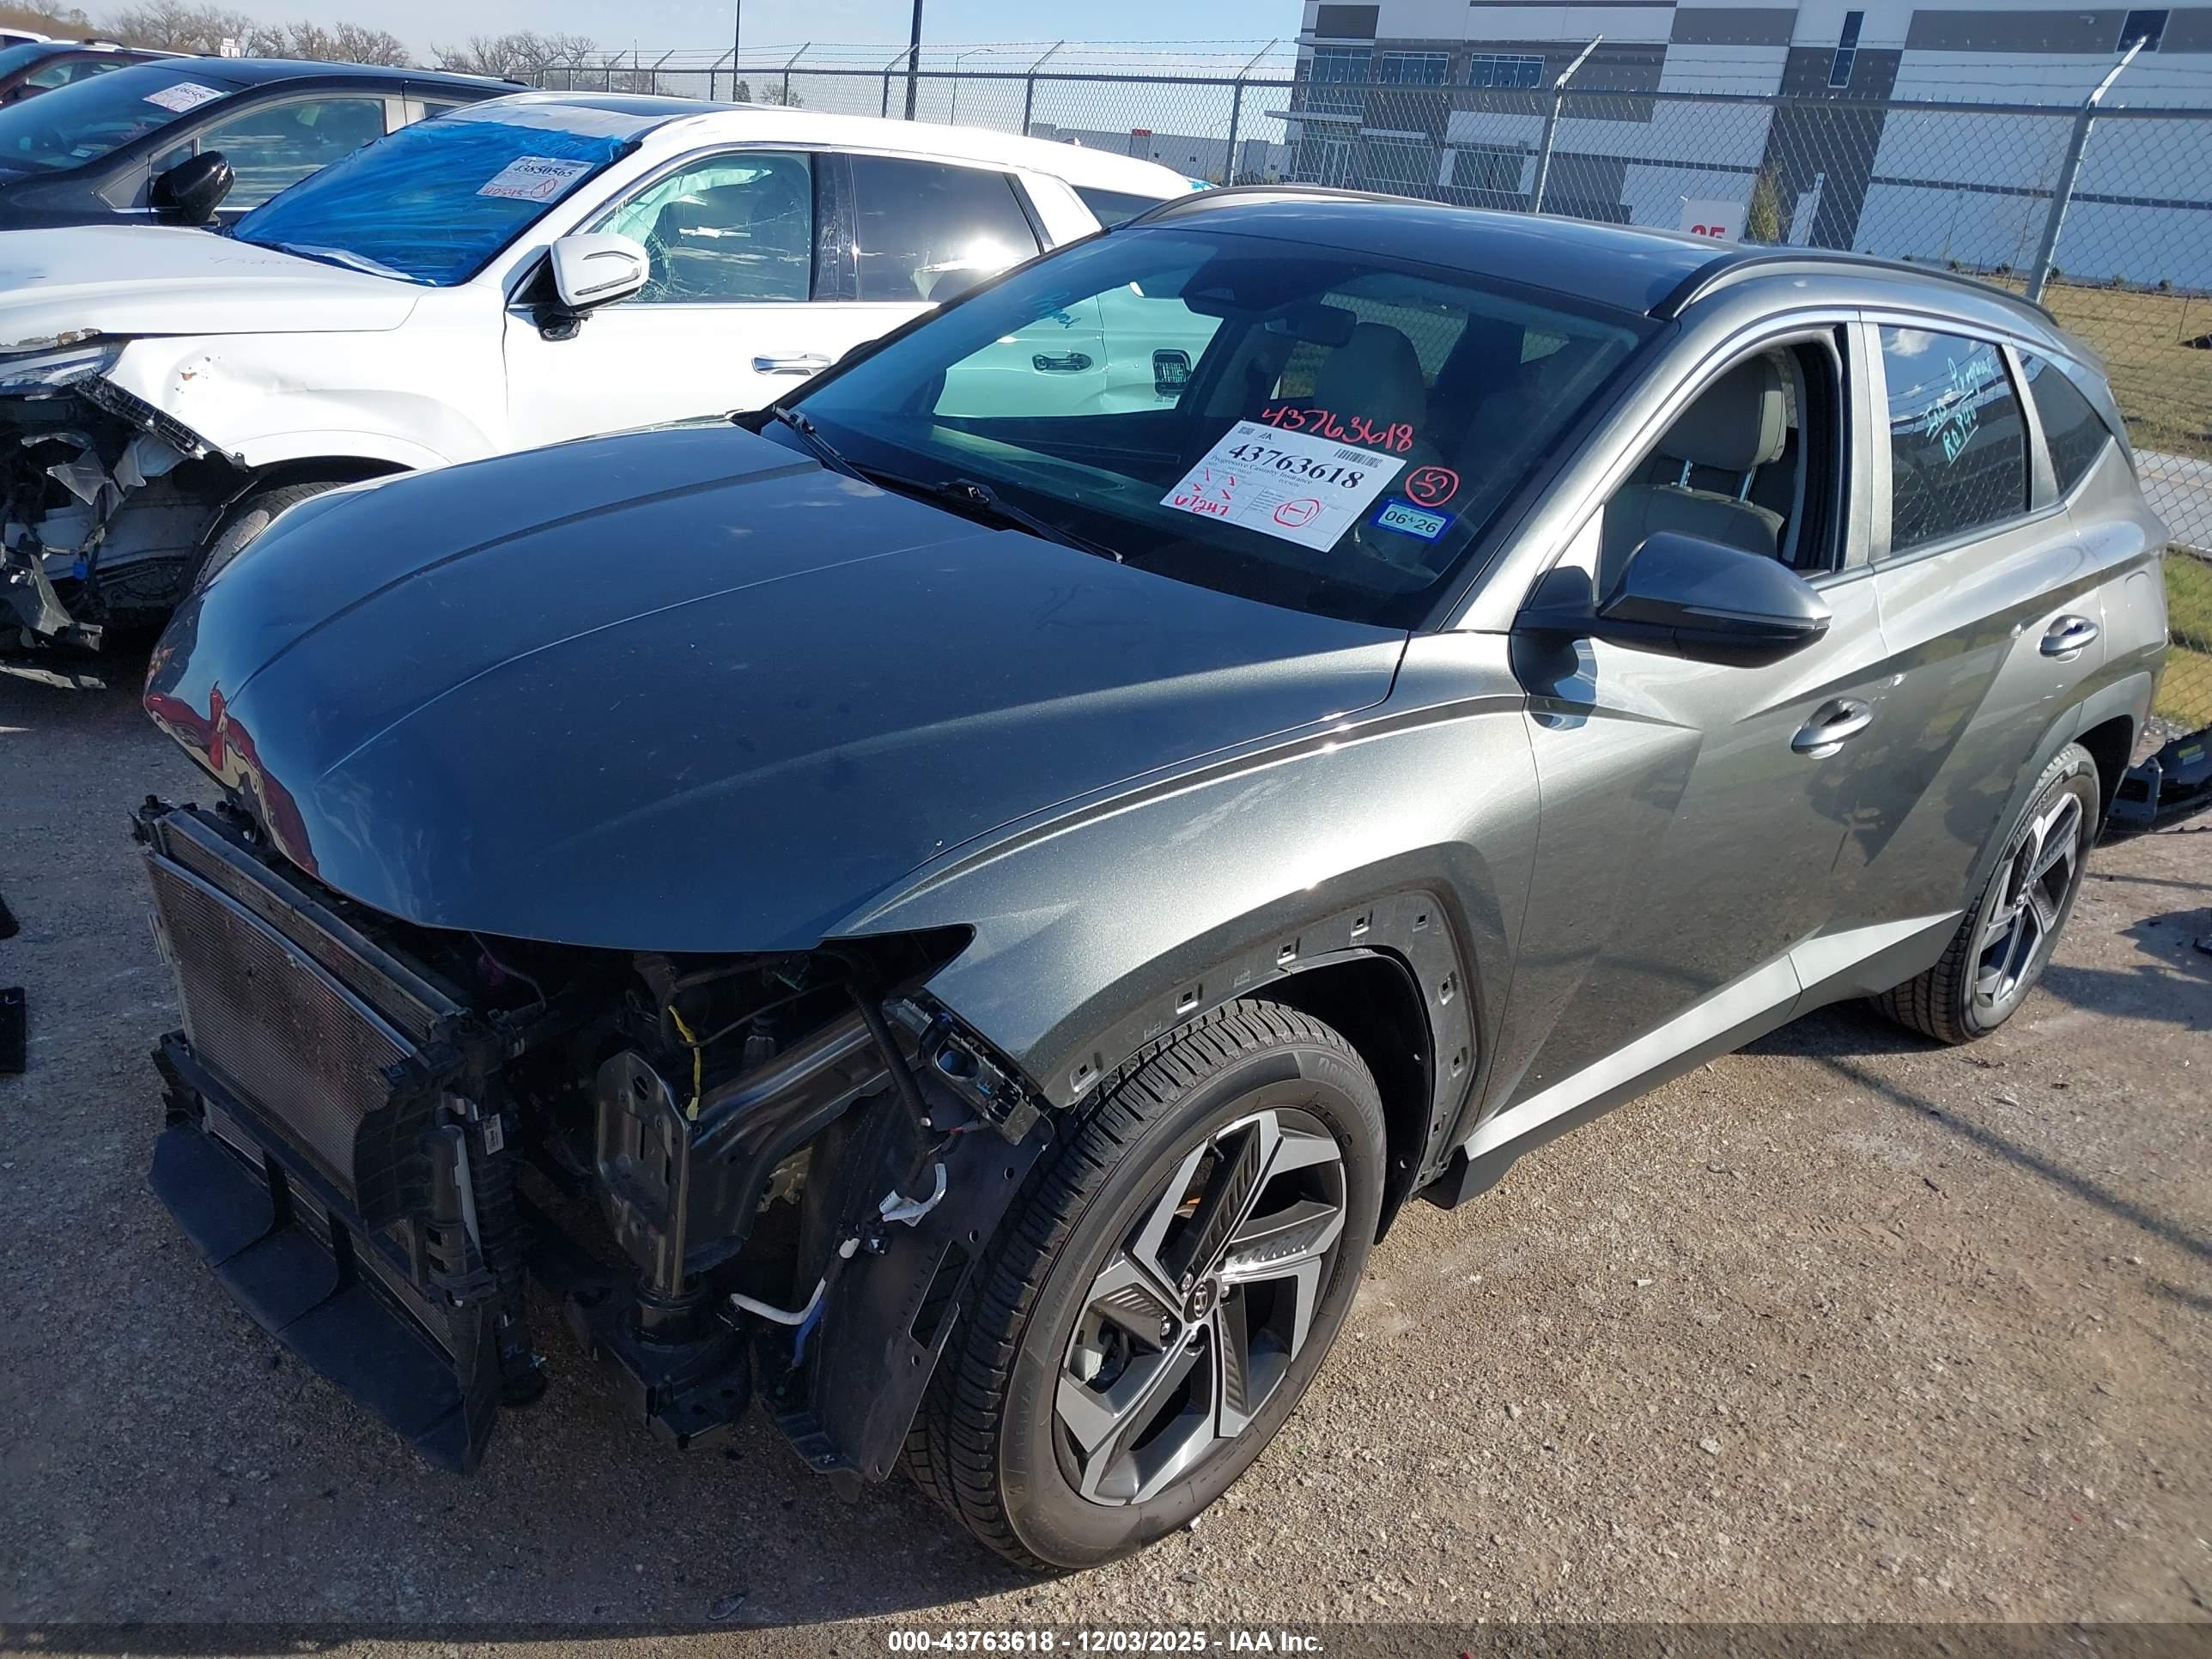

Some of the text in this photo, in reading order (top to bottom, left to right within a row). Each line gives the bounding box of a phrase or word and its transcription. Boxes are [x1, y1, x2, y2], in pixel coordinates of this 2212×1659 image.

[1261, 405, 1415, 453] 43763618
[1210, 453, 1249, 470] Progressive
[1249, 463, 1279, 477] Casualty
[1279, 471, 1314, 485] Insurance
[1227, 442, 1365, 489] 43763618
[1384, 510, 1408, 525] 06
[1413, 519, 1438, 533] 26
